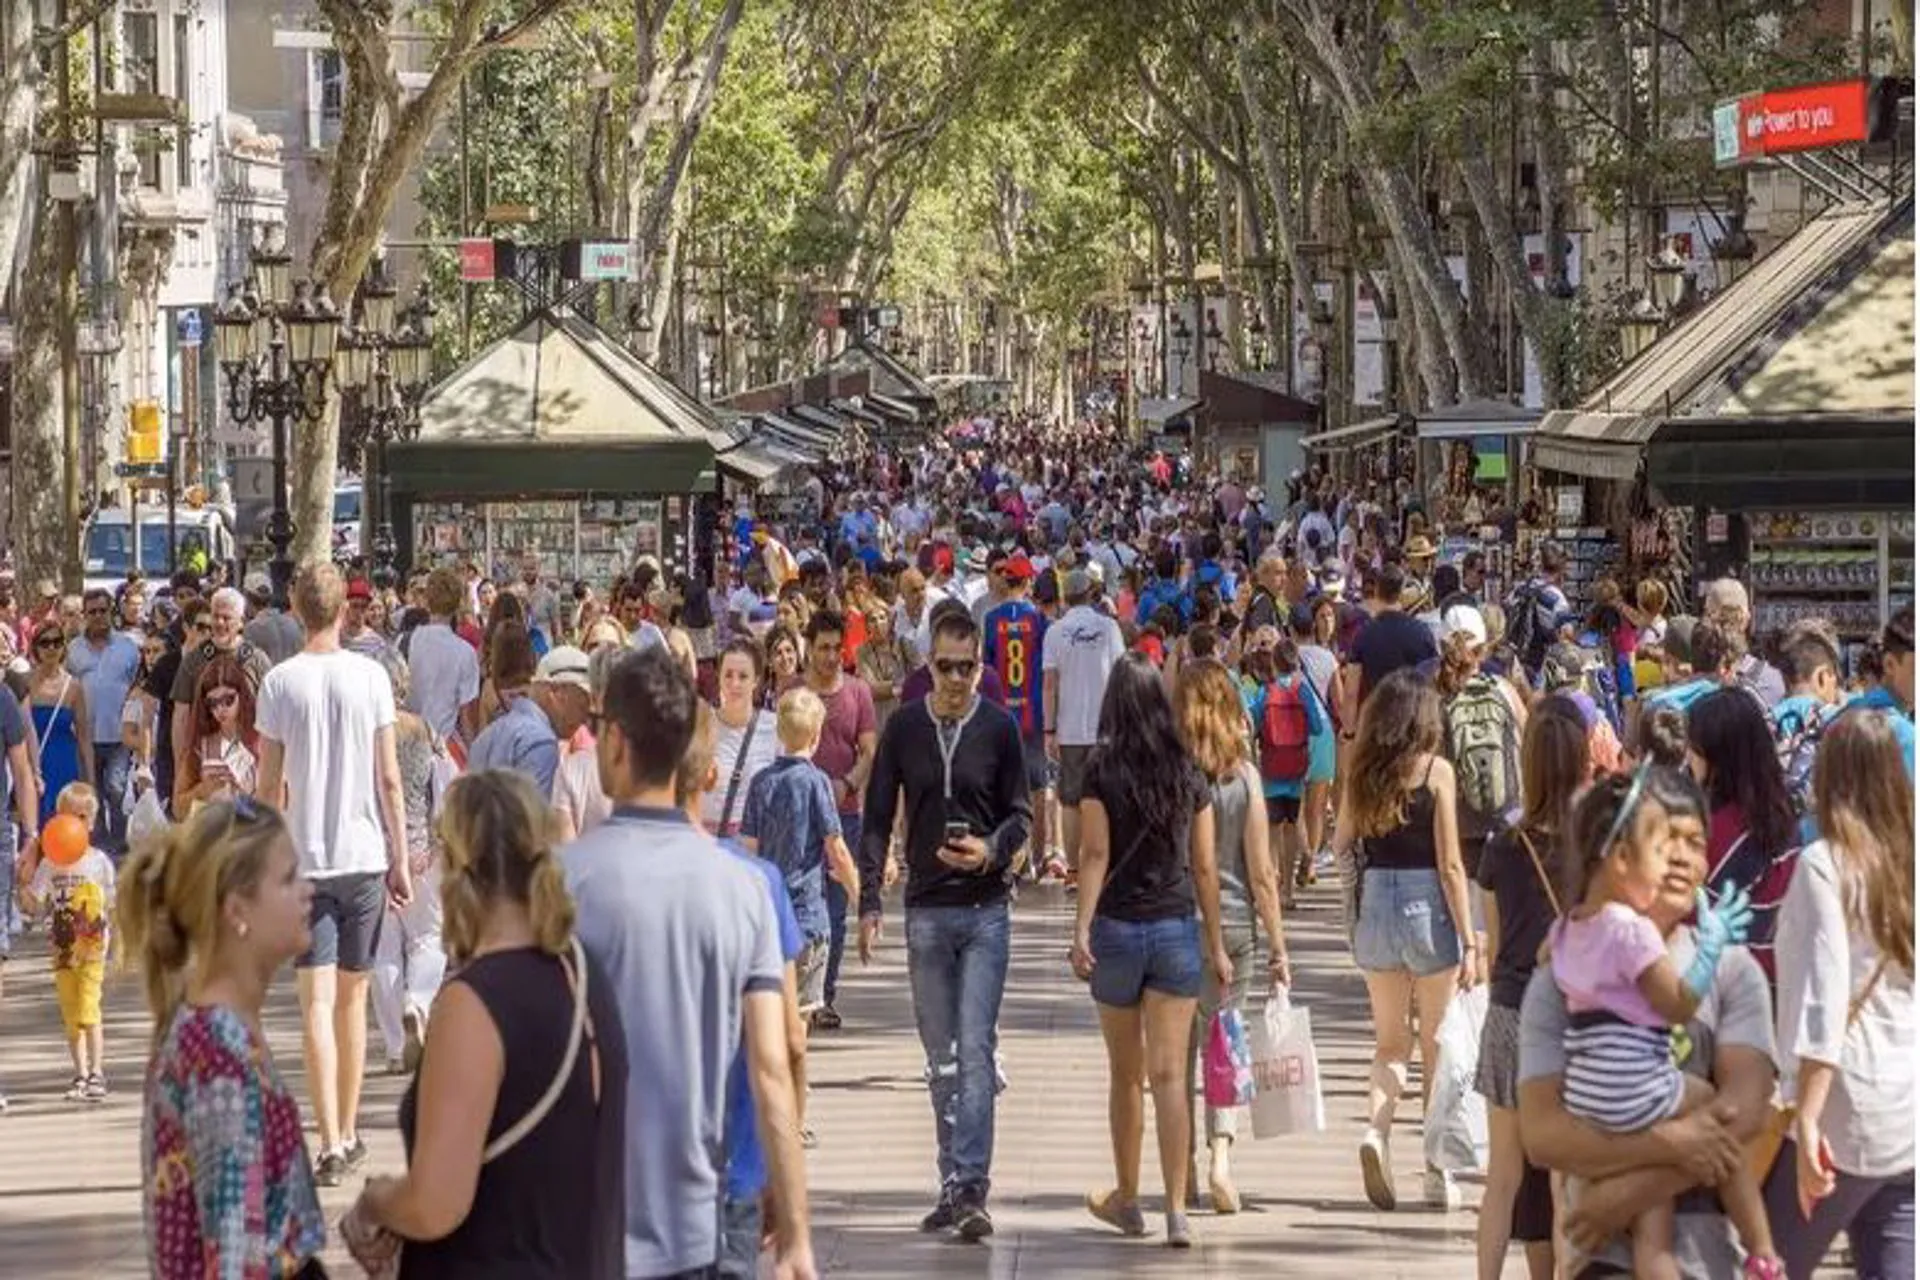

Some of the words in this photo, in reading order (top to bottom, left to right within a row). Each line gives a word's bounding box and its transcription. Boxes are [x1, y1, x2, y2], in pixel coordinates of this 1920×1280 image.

[1798, 108, 1810, 129] to
[1811, 105, 1834, 134] you
[1007, 639, 1025, 688] 8
